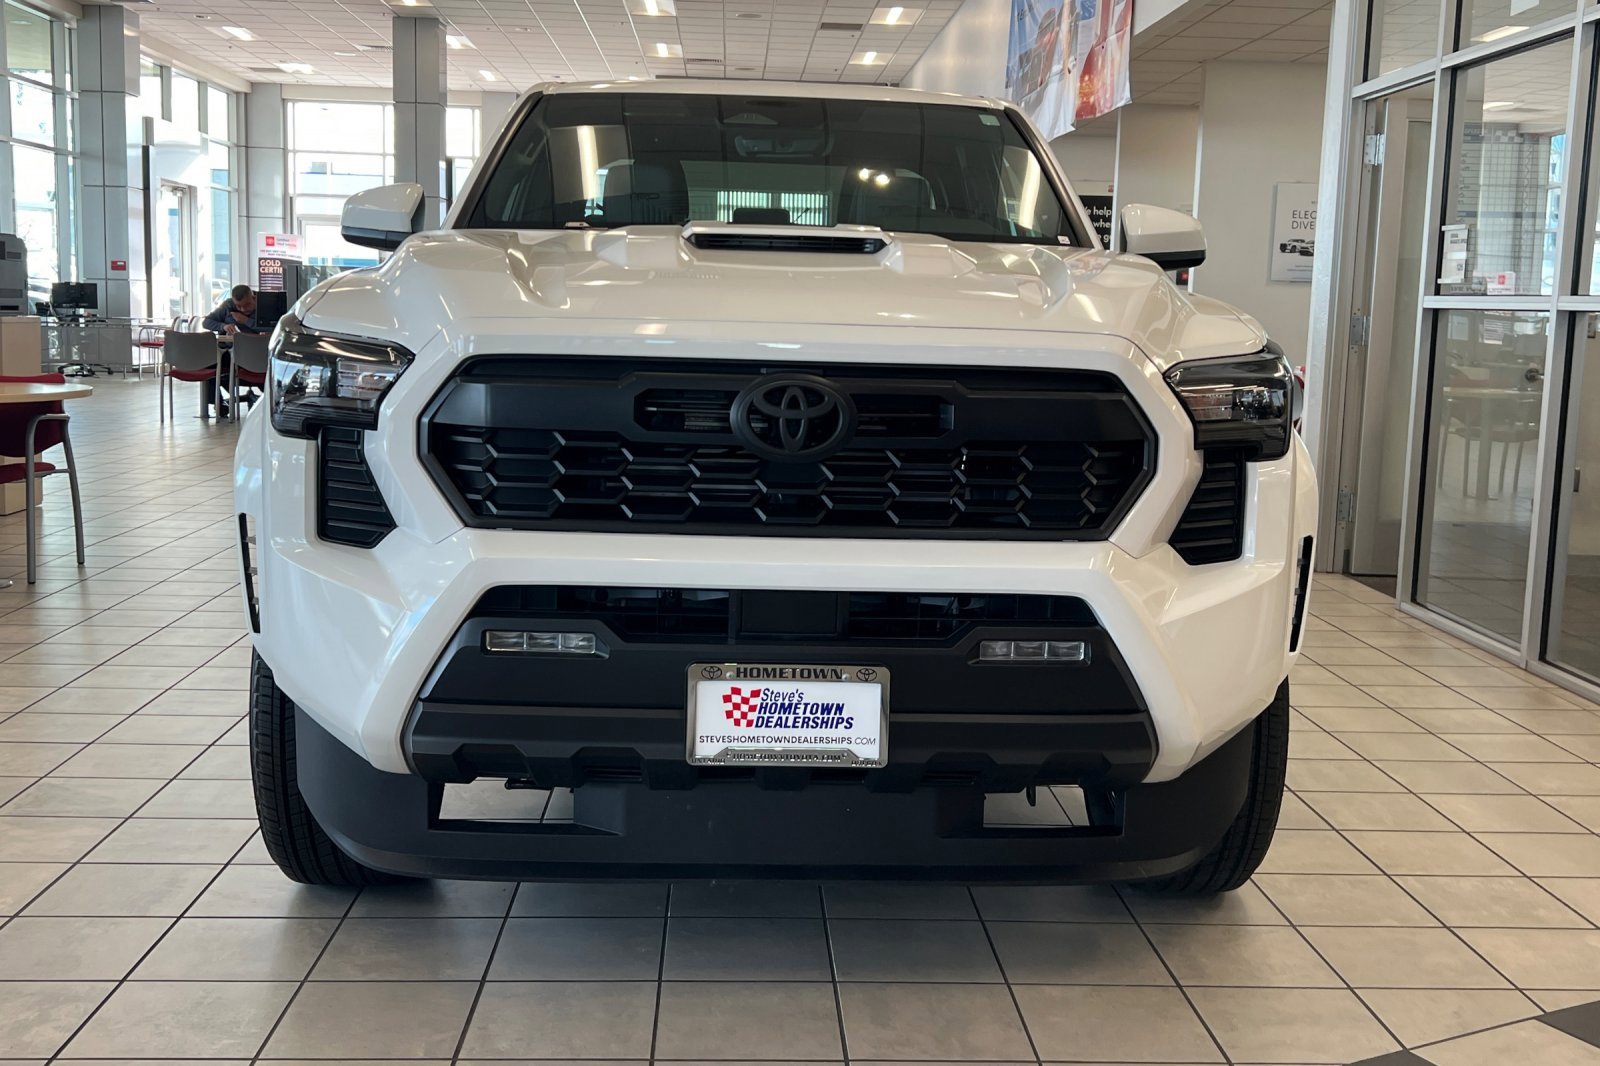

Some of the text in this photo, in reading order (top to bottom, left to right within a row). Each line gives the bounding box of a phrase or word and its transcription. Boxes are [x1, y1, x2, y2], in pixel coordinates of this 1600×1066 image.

[1093, 205, 1112, 218] help
[1291, 220, 1315, 230] DIVE
[260, 259, 281, 267] GOLD
[736, 667, 843, 680] HOMETOWN
[761, 688, 804, 702] Steve's
[757, 702, 845, 716] HOMETOWN
[754, 716, 854, 730] DEALERSHIPS
[699, 735, 876, 745] STEVESHOMETOWNDEALERSHIPS.COM
